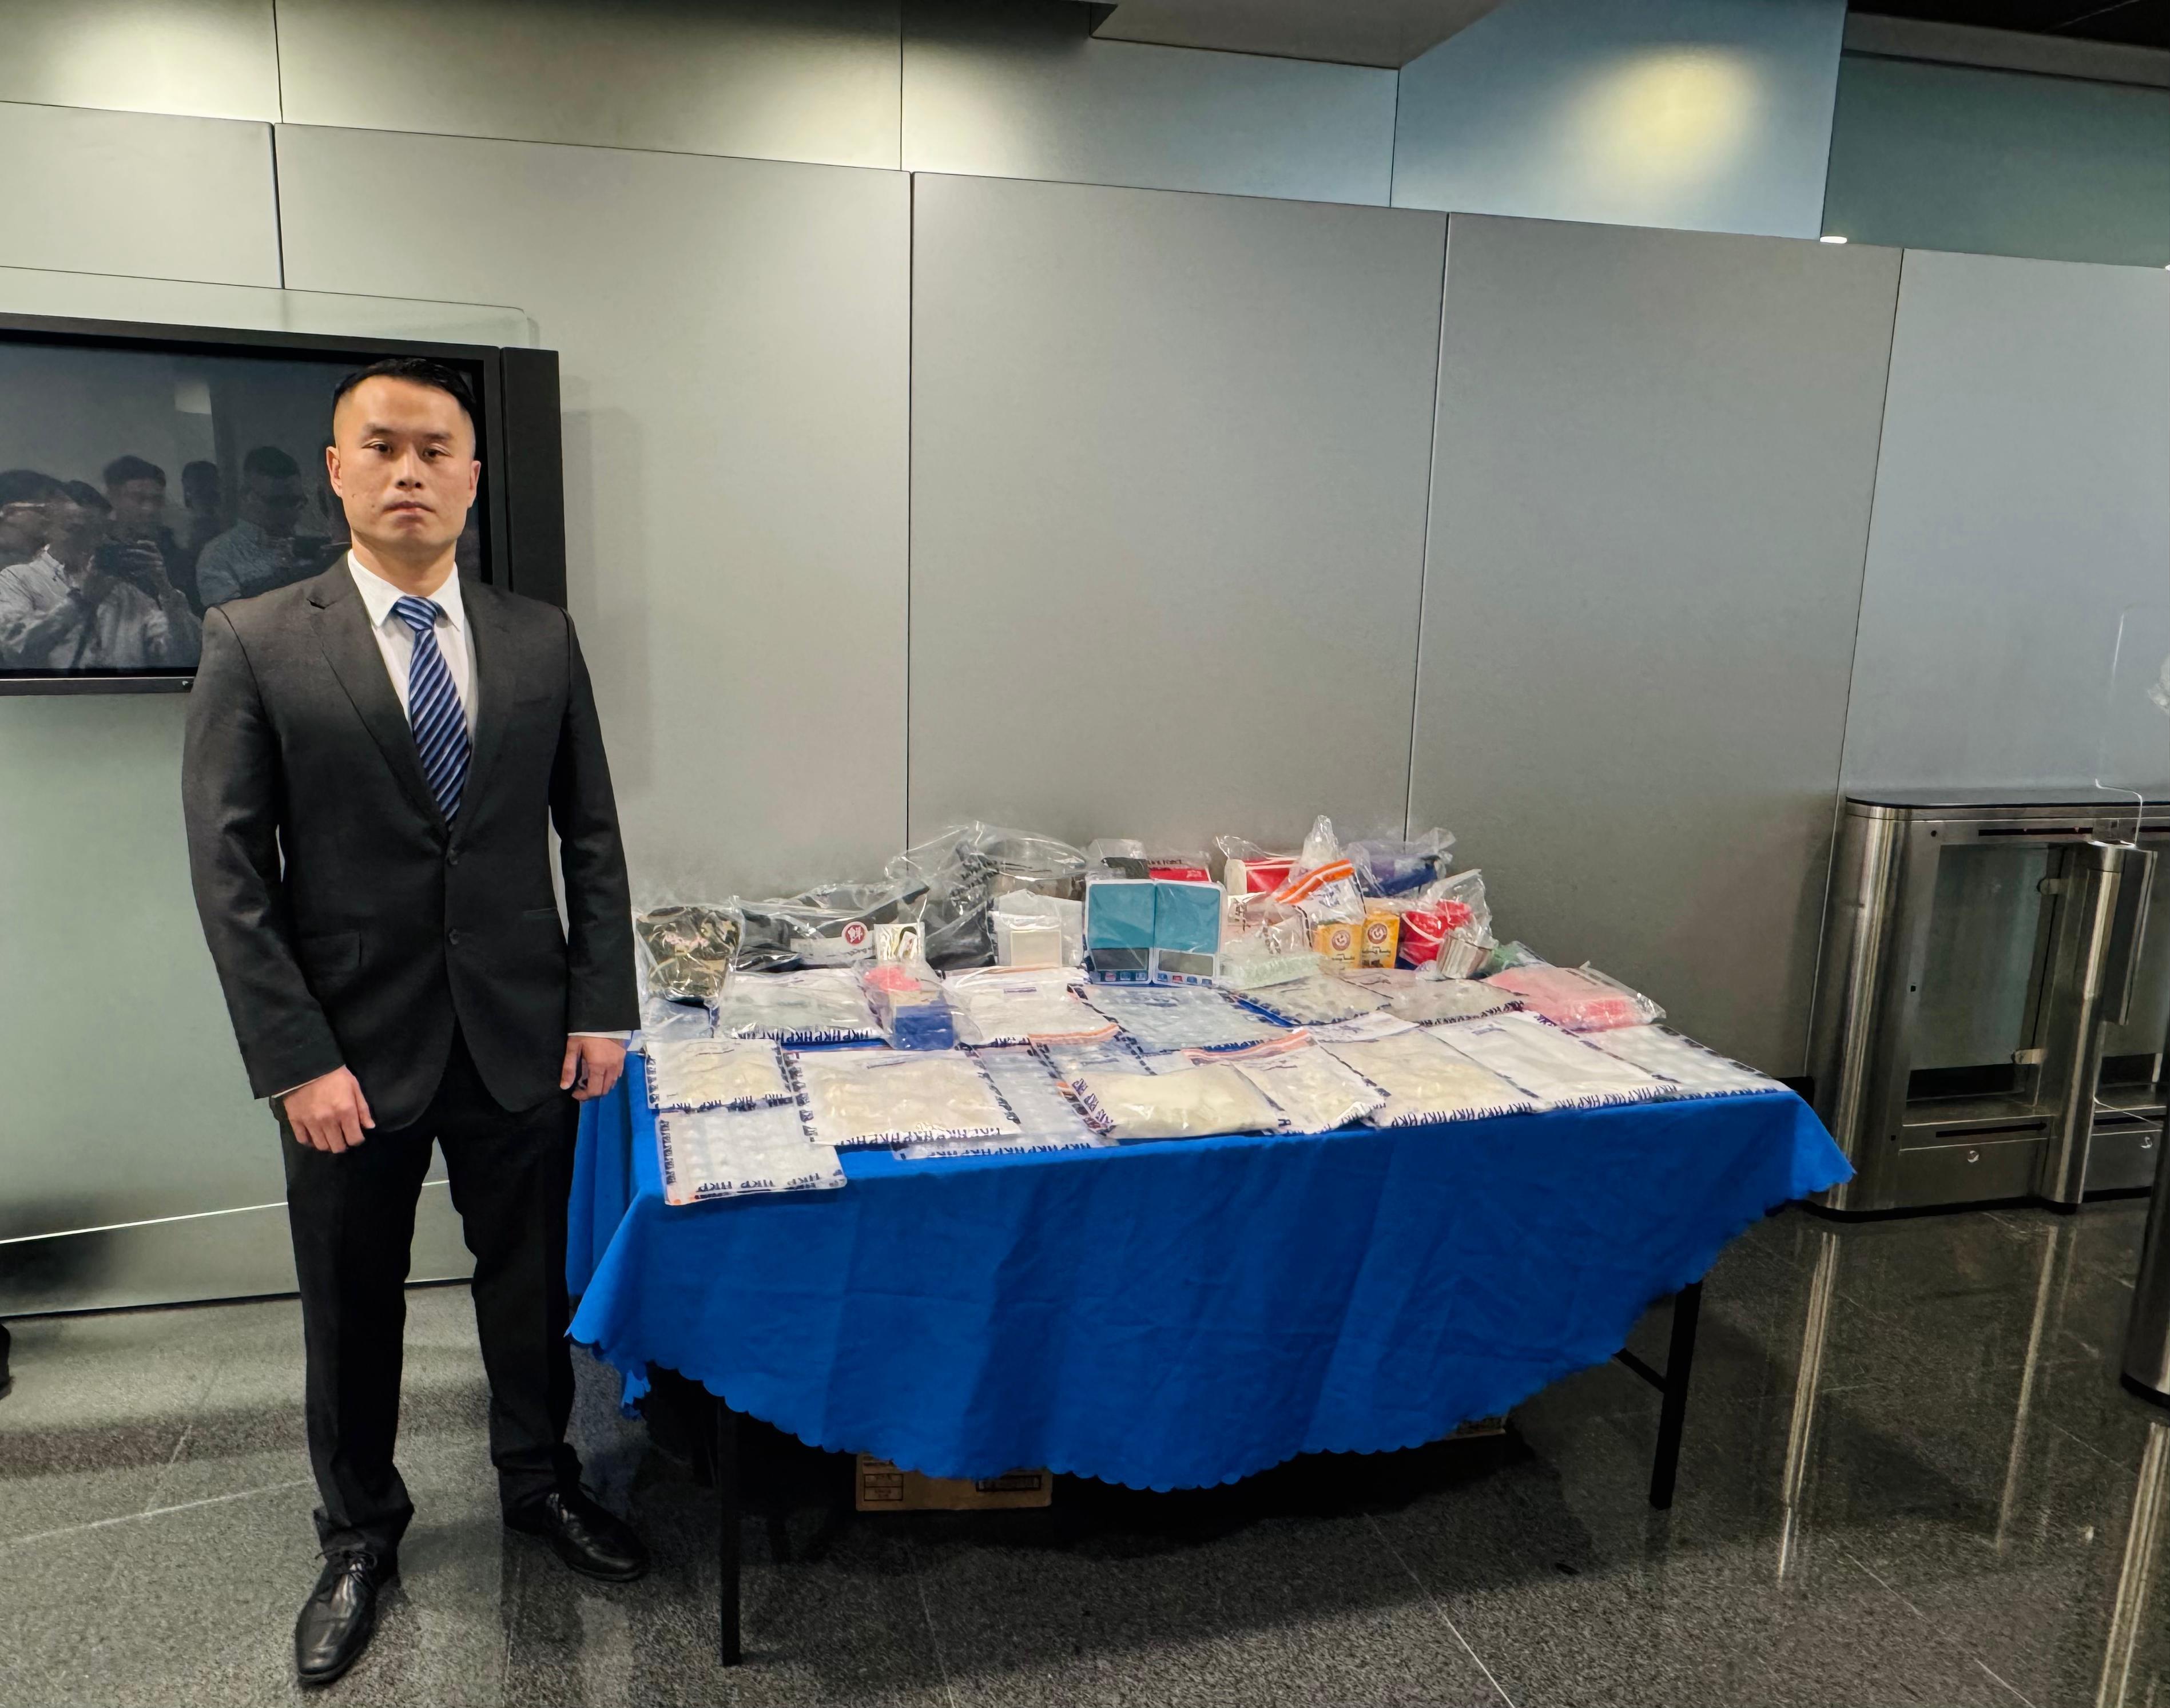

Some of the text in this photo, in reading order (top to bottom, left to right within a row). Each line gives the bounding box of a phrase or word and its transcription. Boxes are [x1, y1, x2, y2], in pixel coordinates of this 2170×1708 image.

[1391, 1113, 1418, 1129] HKP
[1420, 1110, 1447, 1126] HKP
[1449, 1107, 1476, 1123] HKP
[1477, 1105, 1504, 1121] HKP
[695, 1181, 732, 1192] HKP
